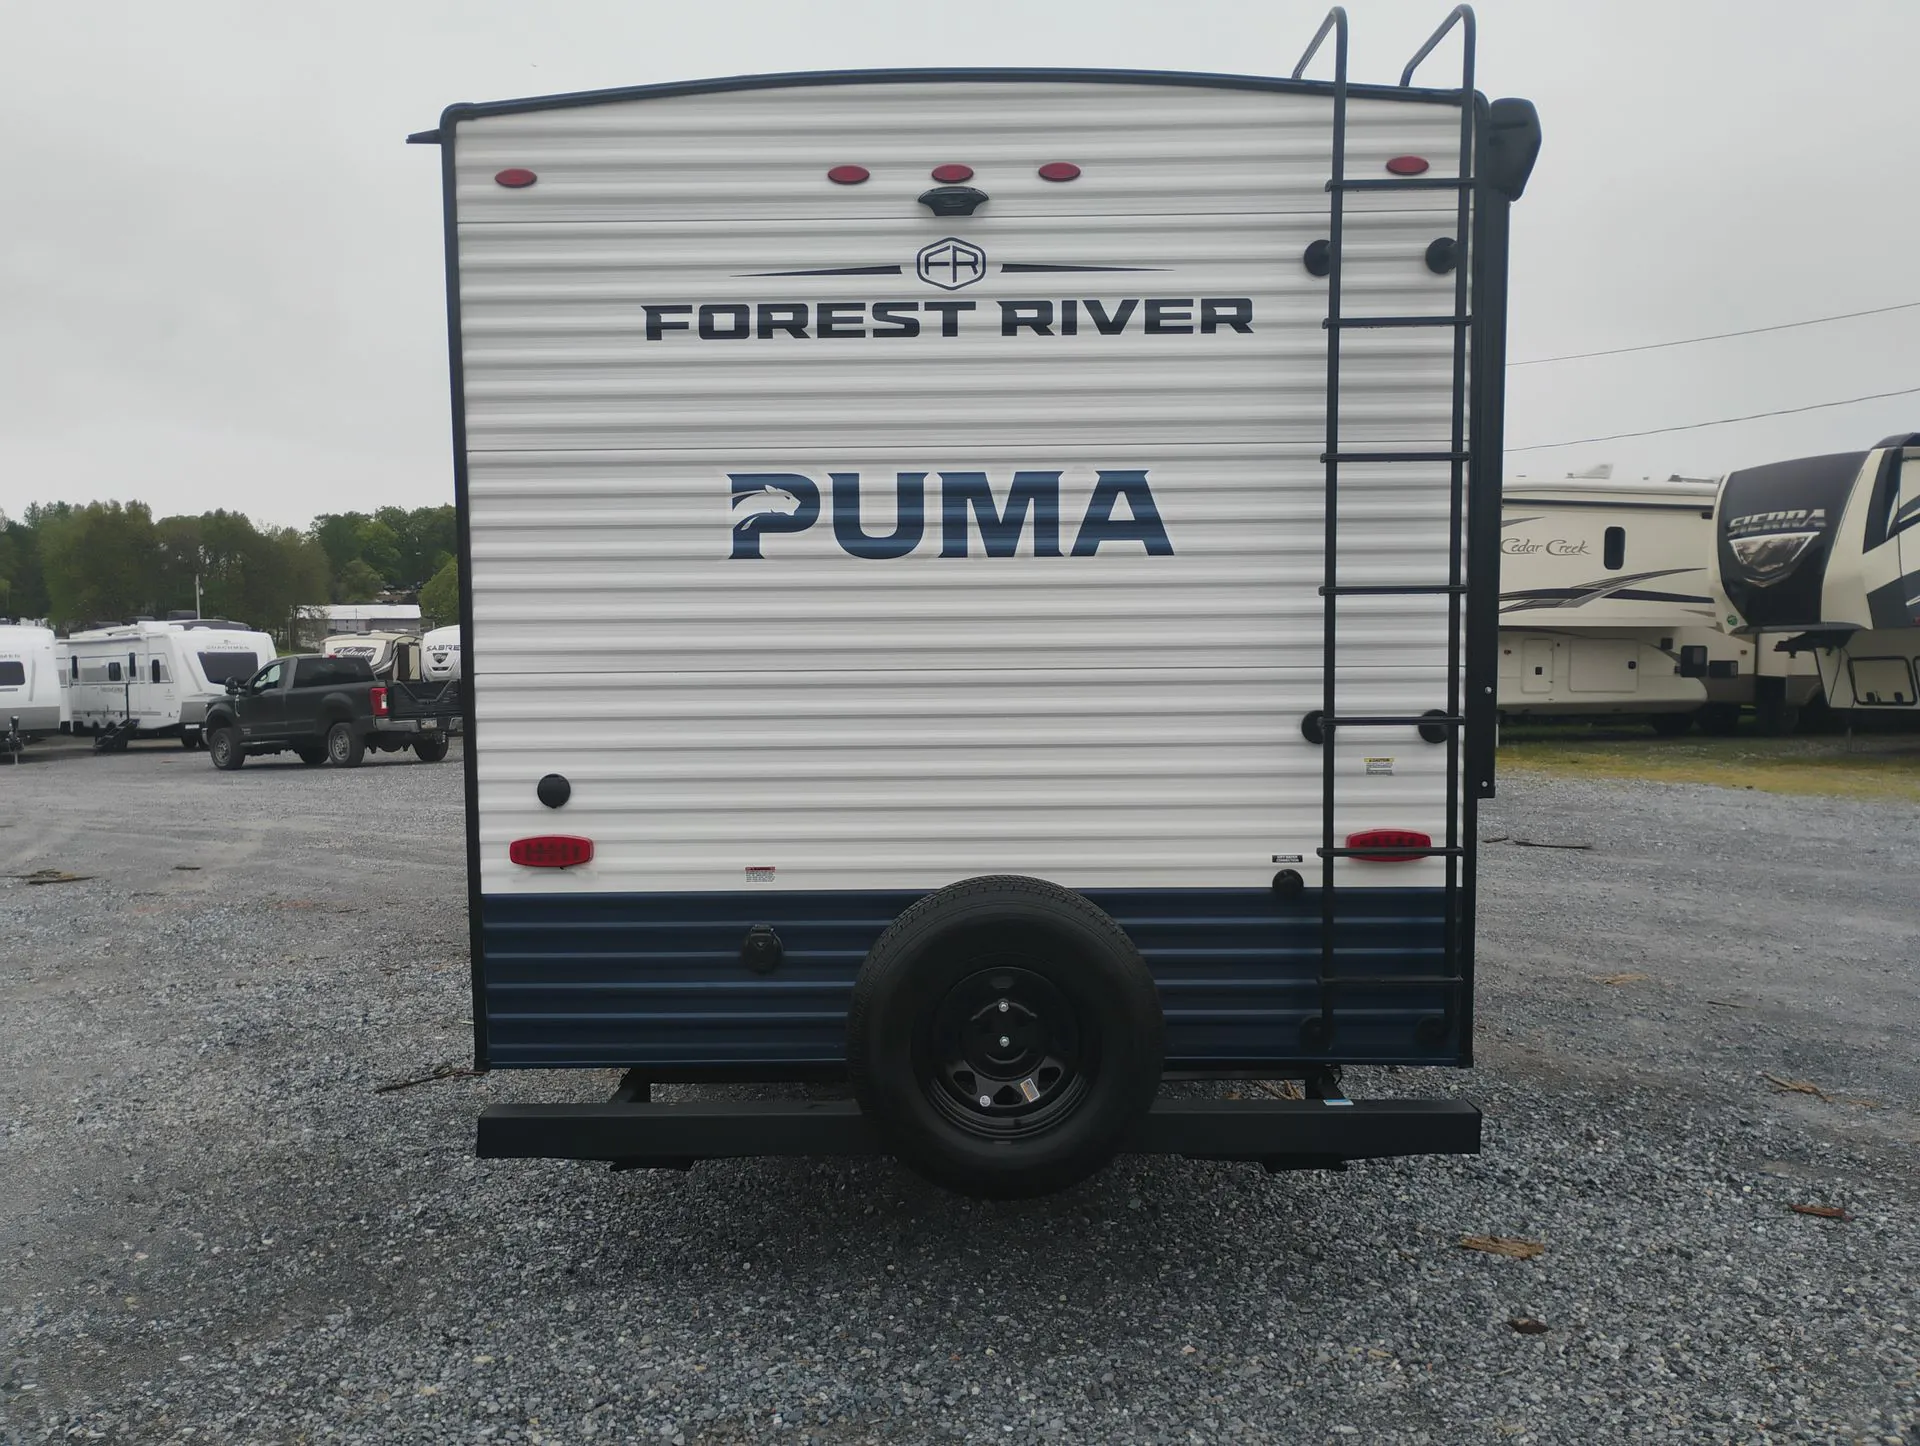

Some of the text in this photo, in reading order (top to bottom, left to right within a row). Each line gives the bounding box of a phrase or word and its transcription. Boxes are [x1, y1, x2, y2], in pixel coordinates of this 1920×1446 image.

[641, 298, 1254, 341] FOREST RIVER
[726, 470, 1176, 560] PUMA
[1727, 508, 1827, 537] SIERRA
[1501, 537, 1592, 556] Cedar Creek
